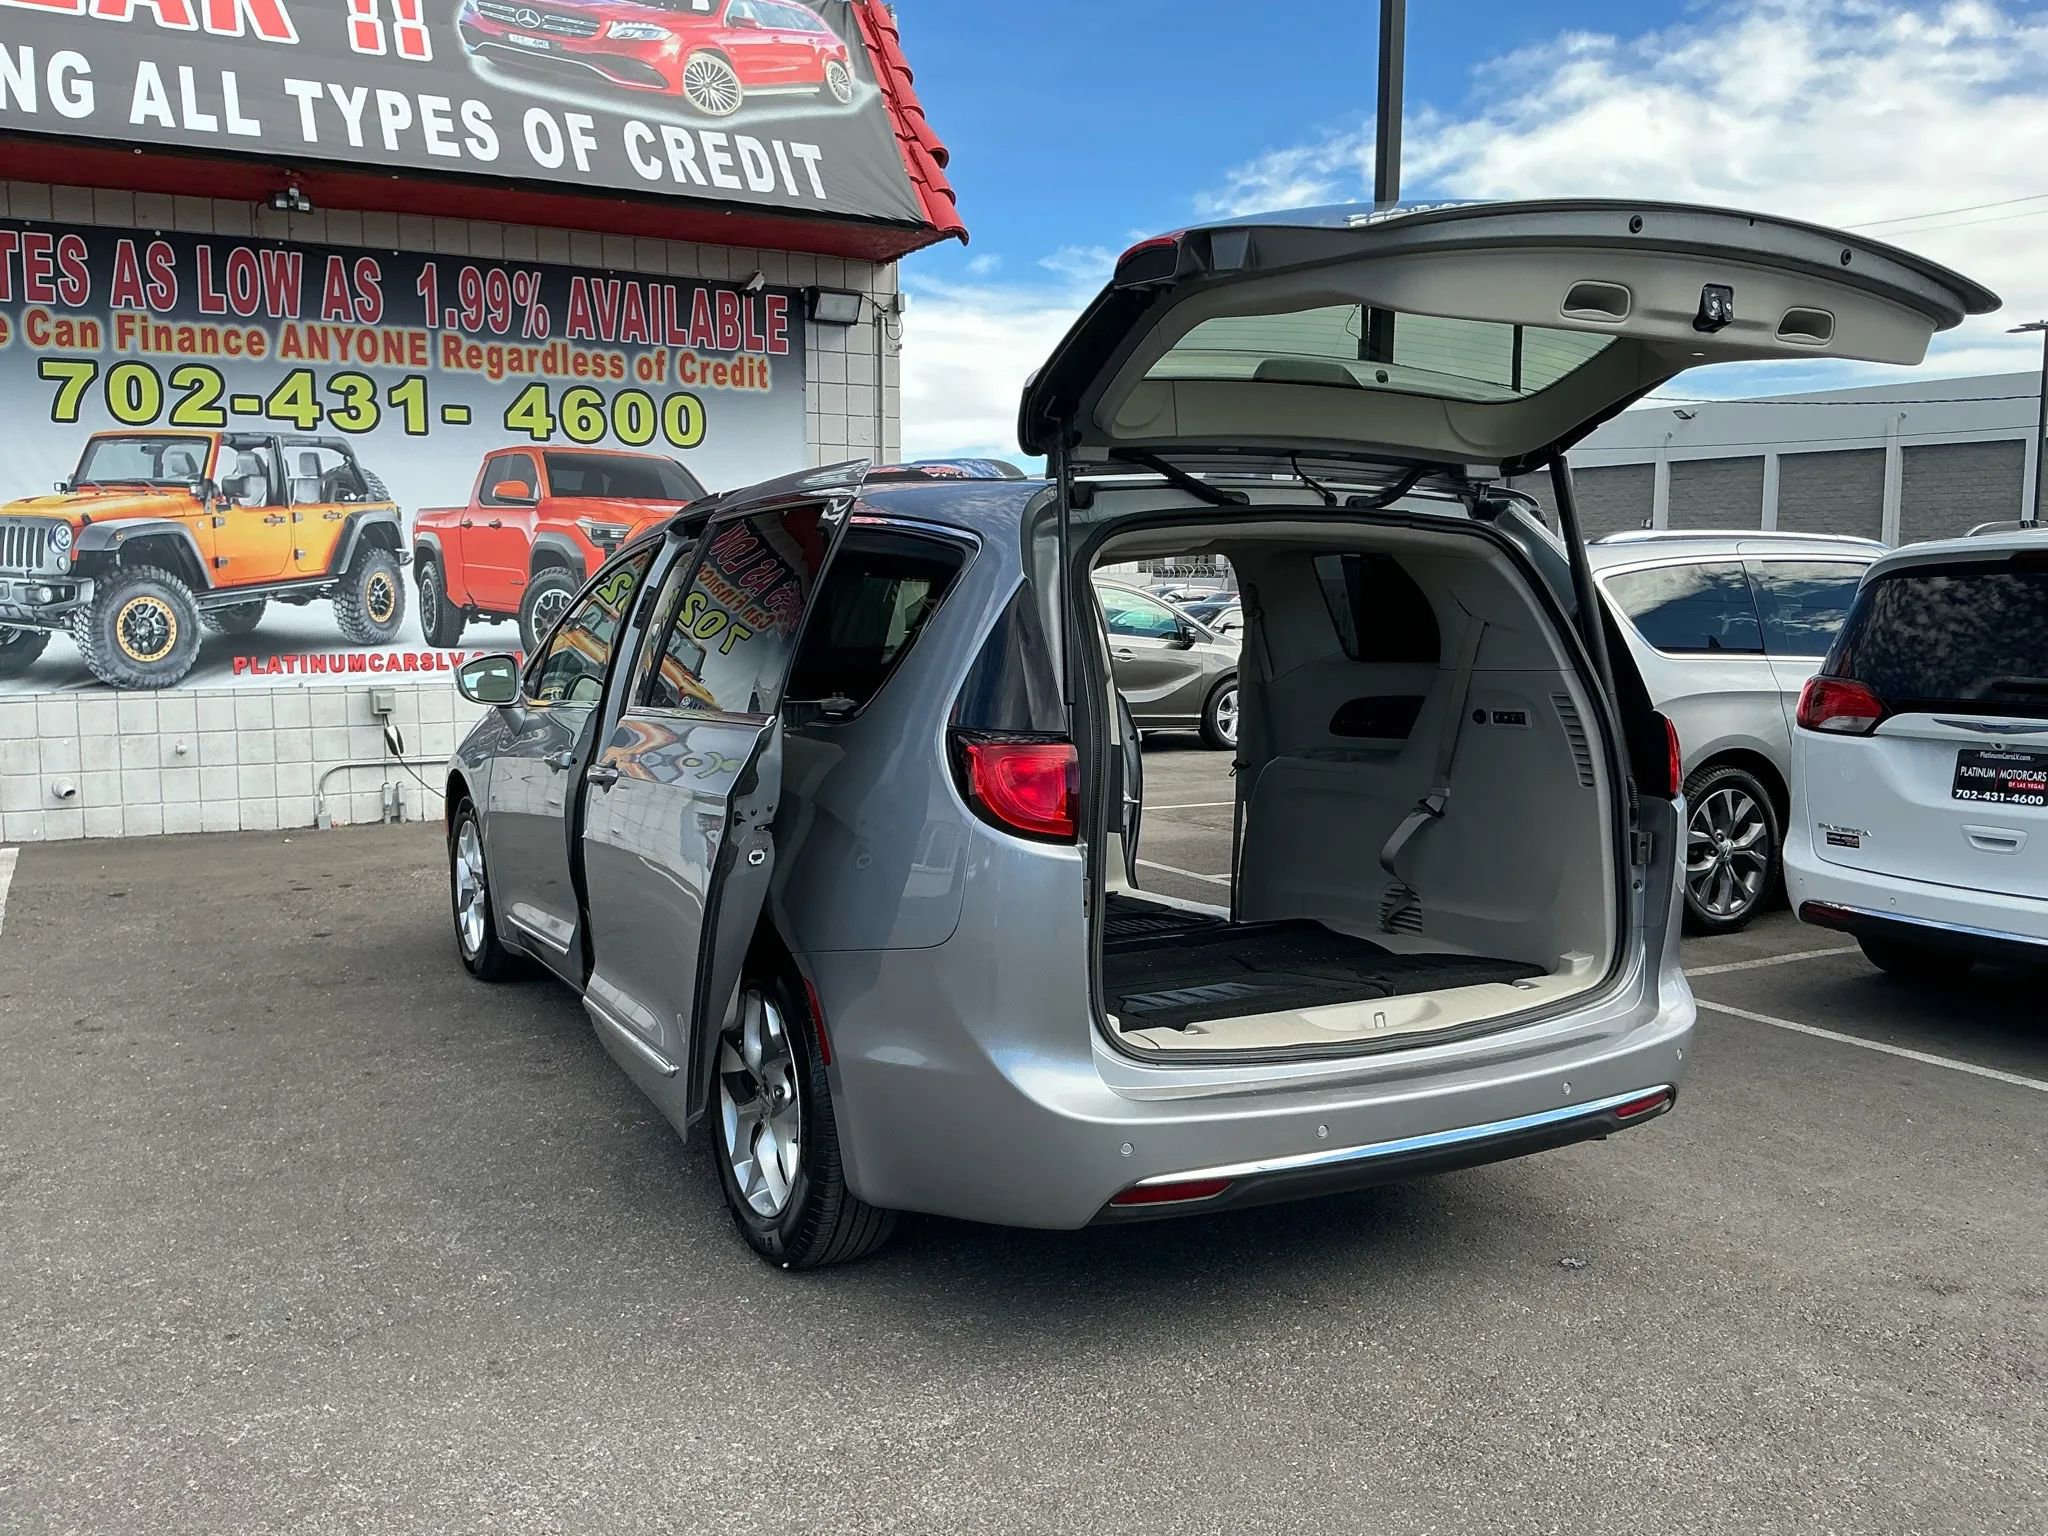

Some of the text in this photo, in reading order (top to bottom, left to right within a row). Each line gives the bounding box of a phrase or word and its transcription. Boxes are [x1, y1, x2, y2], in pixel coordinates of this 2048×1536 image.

[129, 60, 261, 137] ALL
[284, 78, 500, 162] TYPES
[522, 107, 598, 172] OF
[623, 120, 828, 200] CREDIT
[110, 239, 178, 312] AS
[196, 245, 302, 319] LOW
[321, 255, 384, 325] AS
[416, 262, 551, 340] 1.99%
[566, 275, 790, 356] AVAILABLE
[26, 308, 98, 348] Can
[116, 313, 265, 356] Finance
[281, 323, 428, 366] ANYONE
[443, 335, 625, 380] Regardless
[637, 349, 666, 382] of
[679, 353, 769, 389] Credit
[233, 651, 524, 676] PLATINUMCARSLV
[1955, 789, 2044, 805] 702-431-4600
[1960, 766, 2047, 782] PLATINUM MOTORCARS
